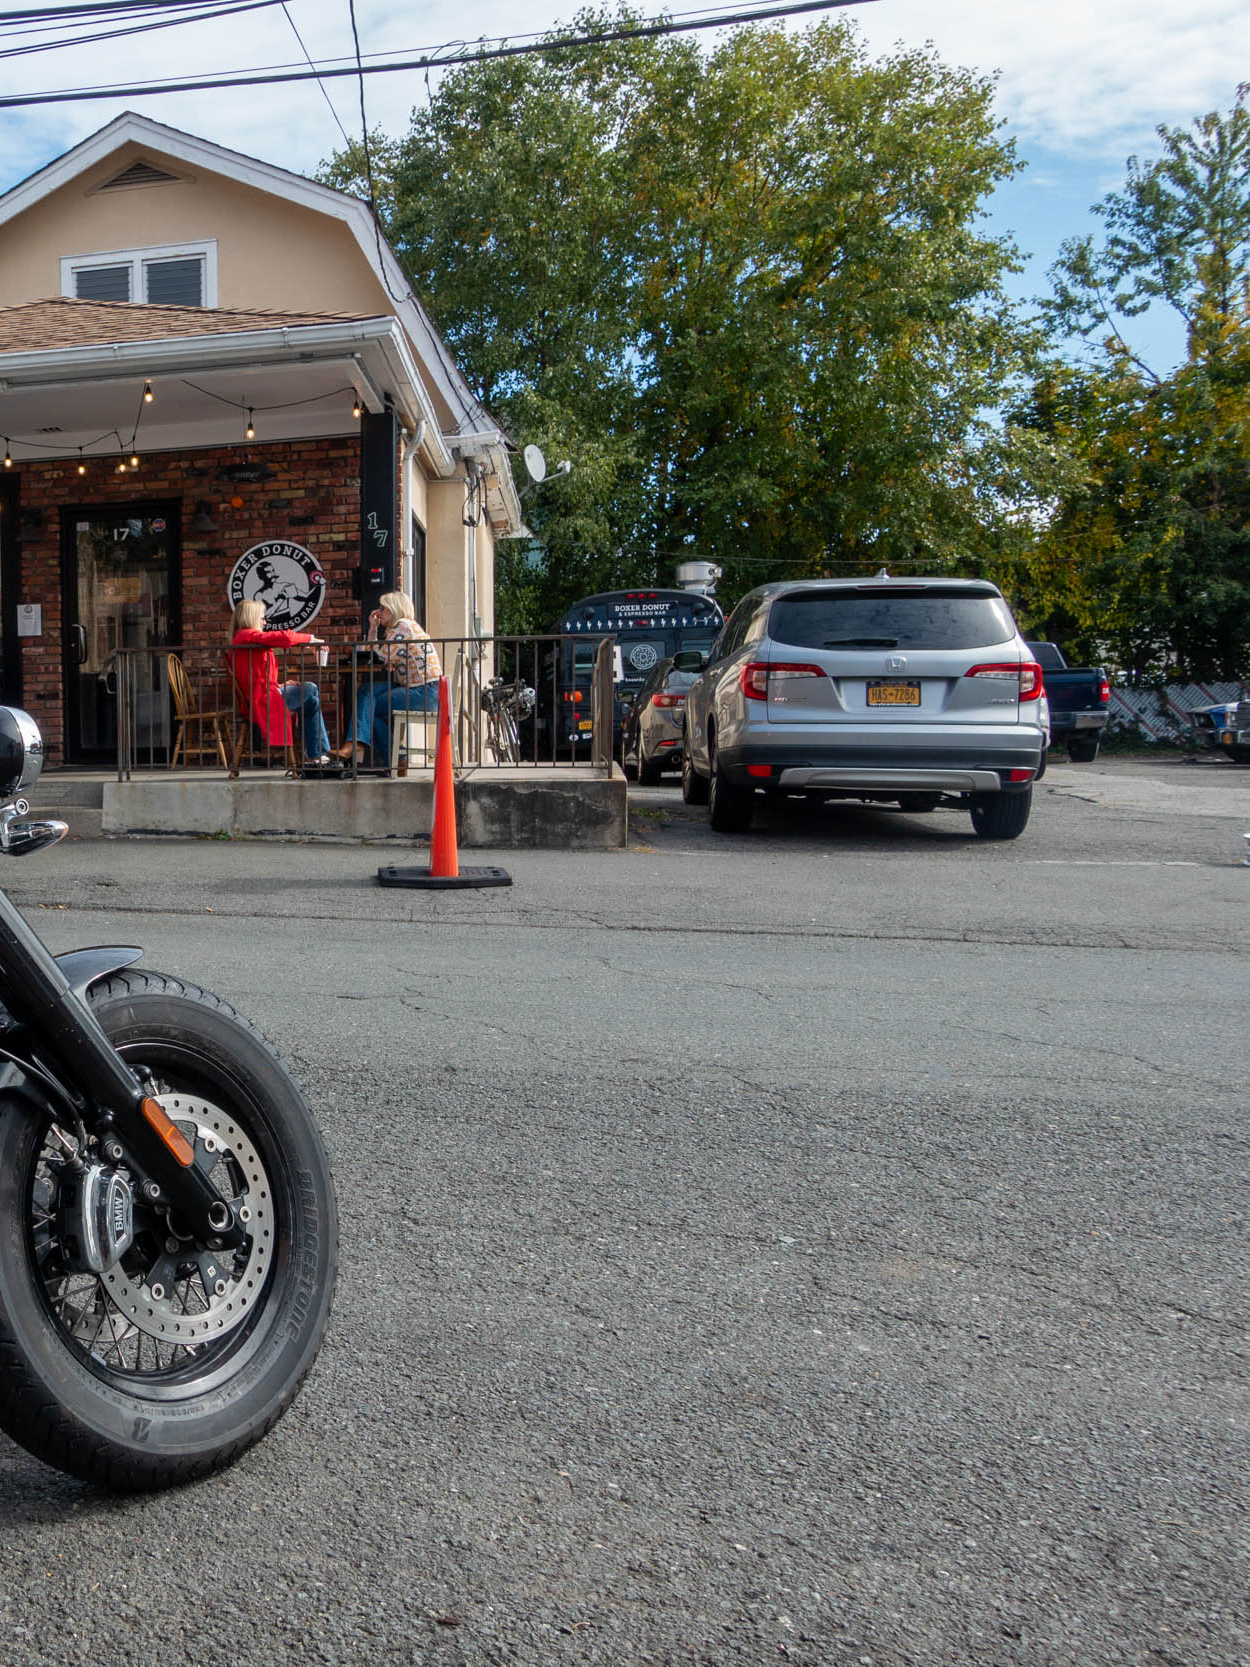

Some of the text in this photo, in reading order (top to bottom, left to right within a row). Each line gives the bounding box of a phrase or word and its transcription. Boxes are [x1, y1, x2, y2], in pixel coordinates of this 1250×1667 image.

[113, 528, 130, 541] 17
[367, 511, 388, 548] 17
[233, 545, 311, 600] BOXER DONUT
[265, 601, 317, 631] PRESSO BAR
[642, 603, 671, 611] DONUT
[114, 1196, 124, 1231] BMW
[285, 1169, 319, 1344] BRIDGESTONE
